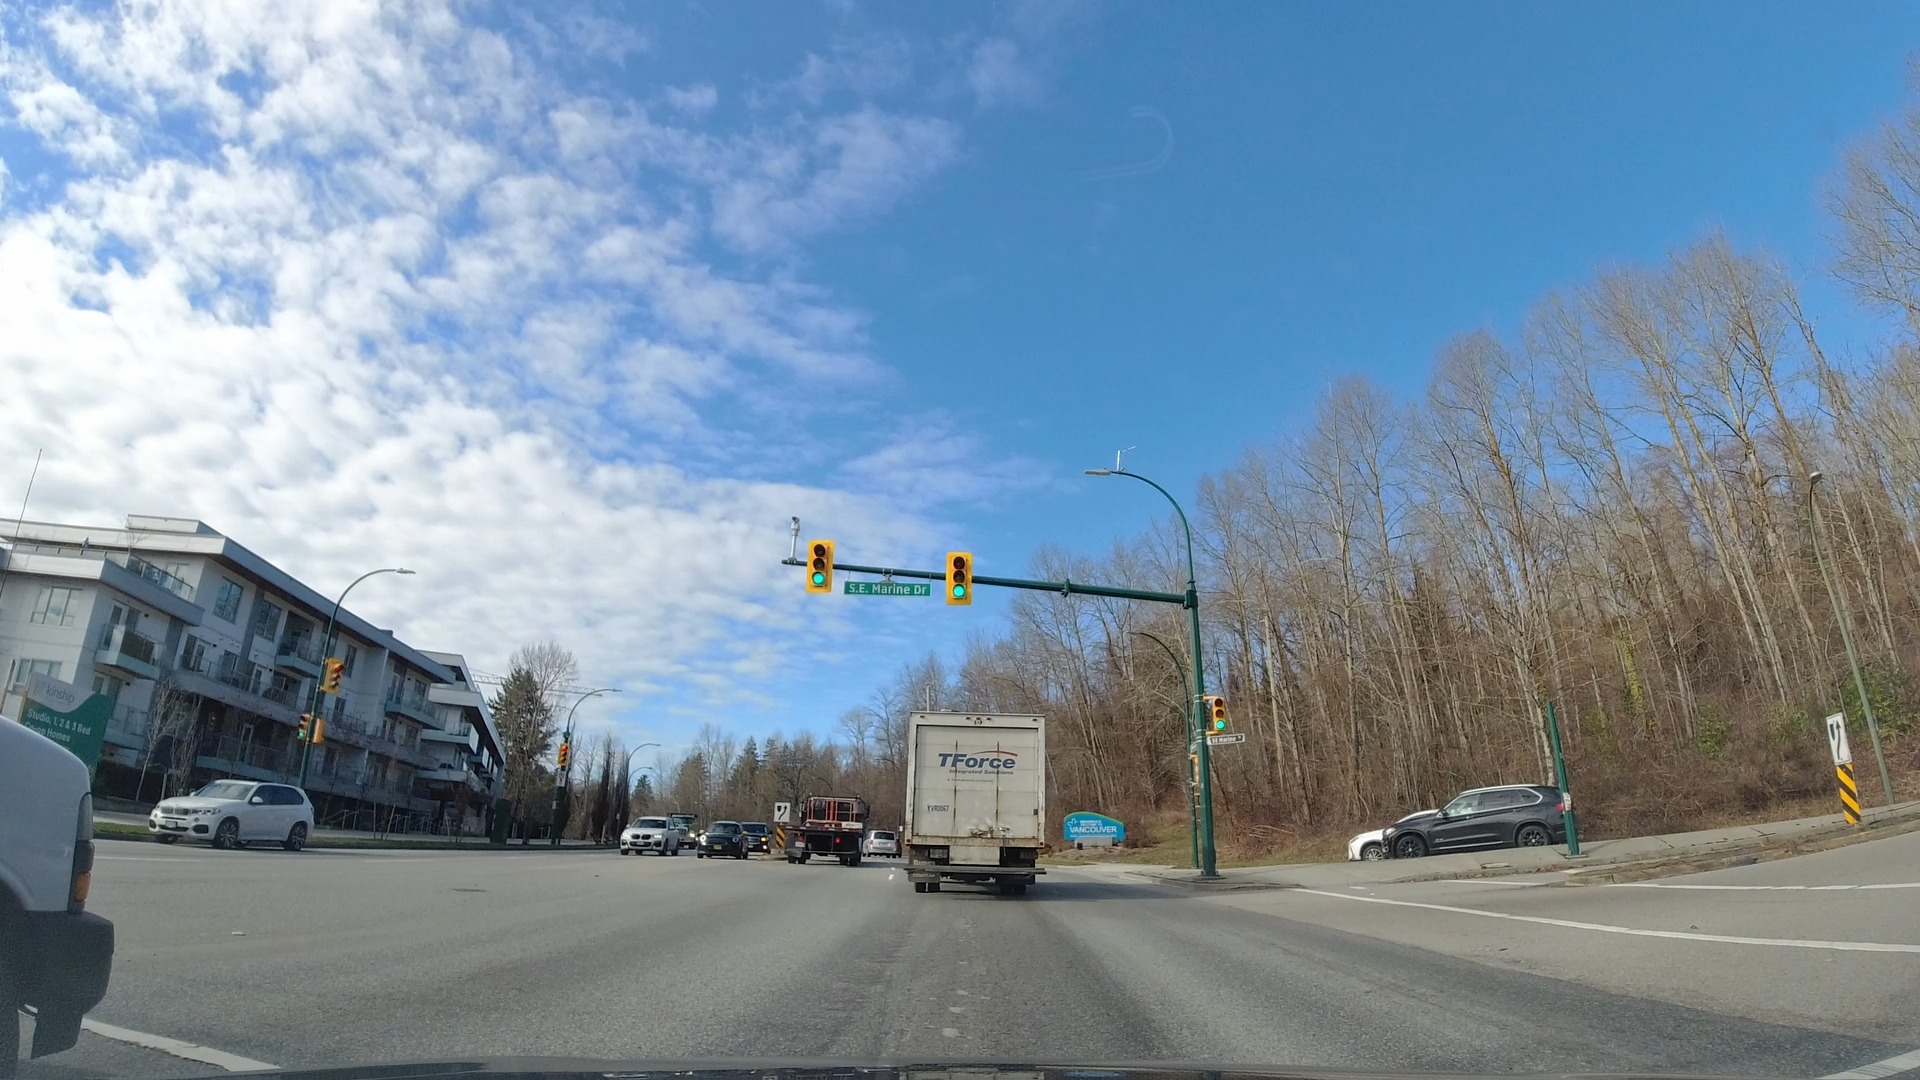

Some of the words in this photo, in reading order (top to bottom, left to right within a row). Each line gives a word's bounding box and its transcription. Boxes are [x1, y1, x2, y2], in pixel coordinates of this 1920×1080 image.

[849, 583, 868, 593] S.E.
[872, 583, 910, 595] Marine
[914, 585, 927, 595] Dr
[46, 686, 75, 706] kinship
[27, 708, 52, 725] Studio,
[59, 719, 65, 728] 2
[65, 720, 71, 730] &
[72, 721, 77, 731] 3
[77, 724, 91, 736] Bed
[46, 728, 71, 742] Homes
[938, 753, 1016, 769] TForce
